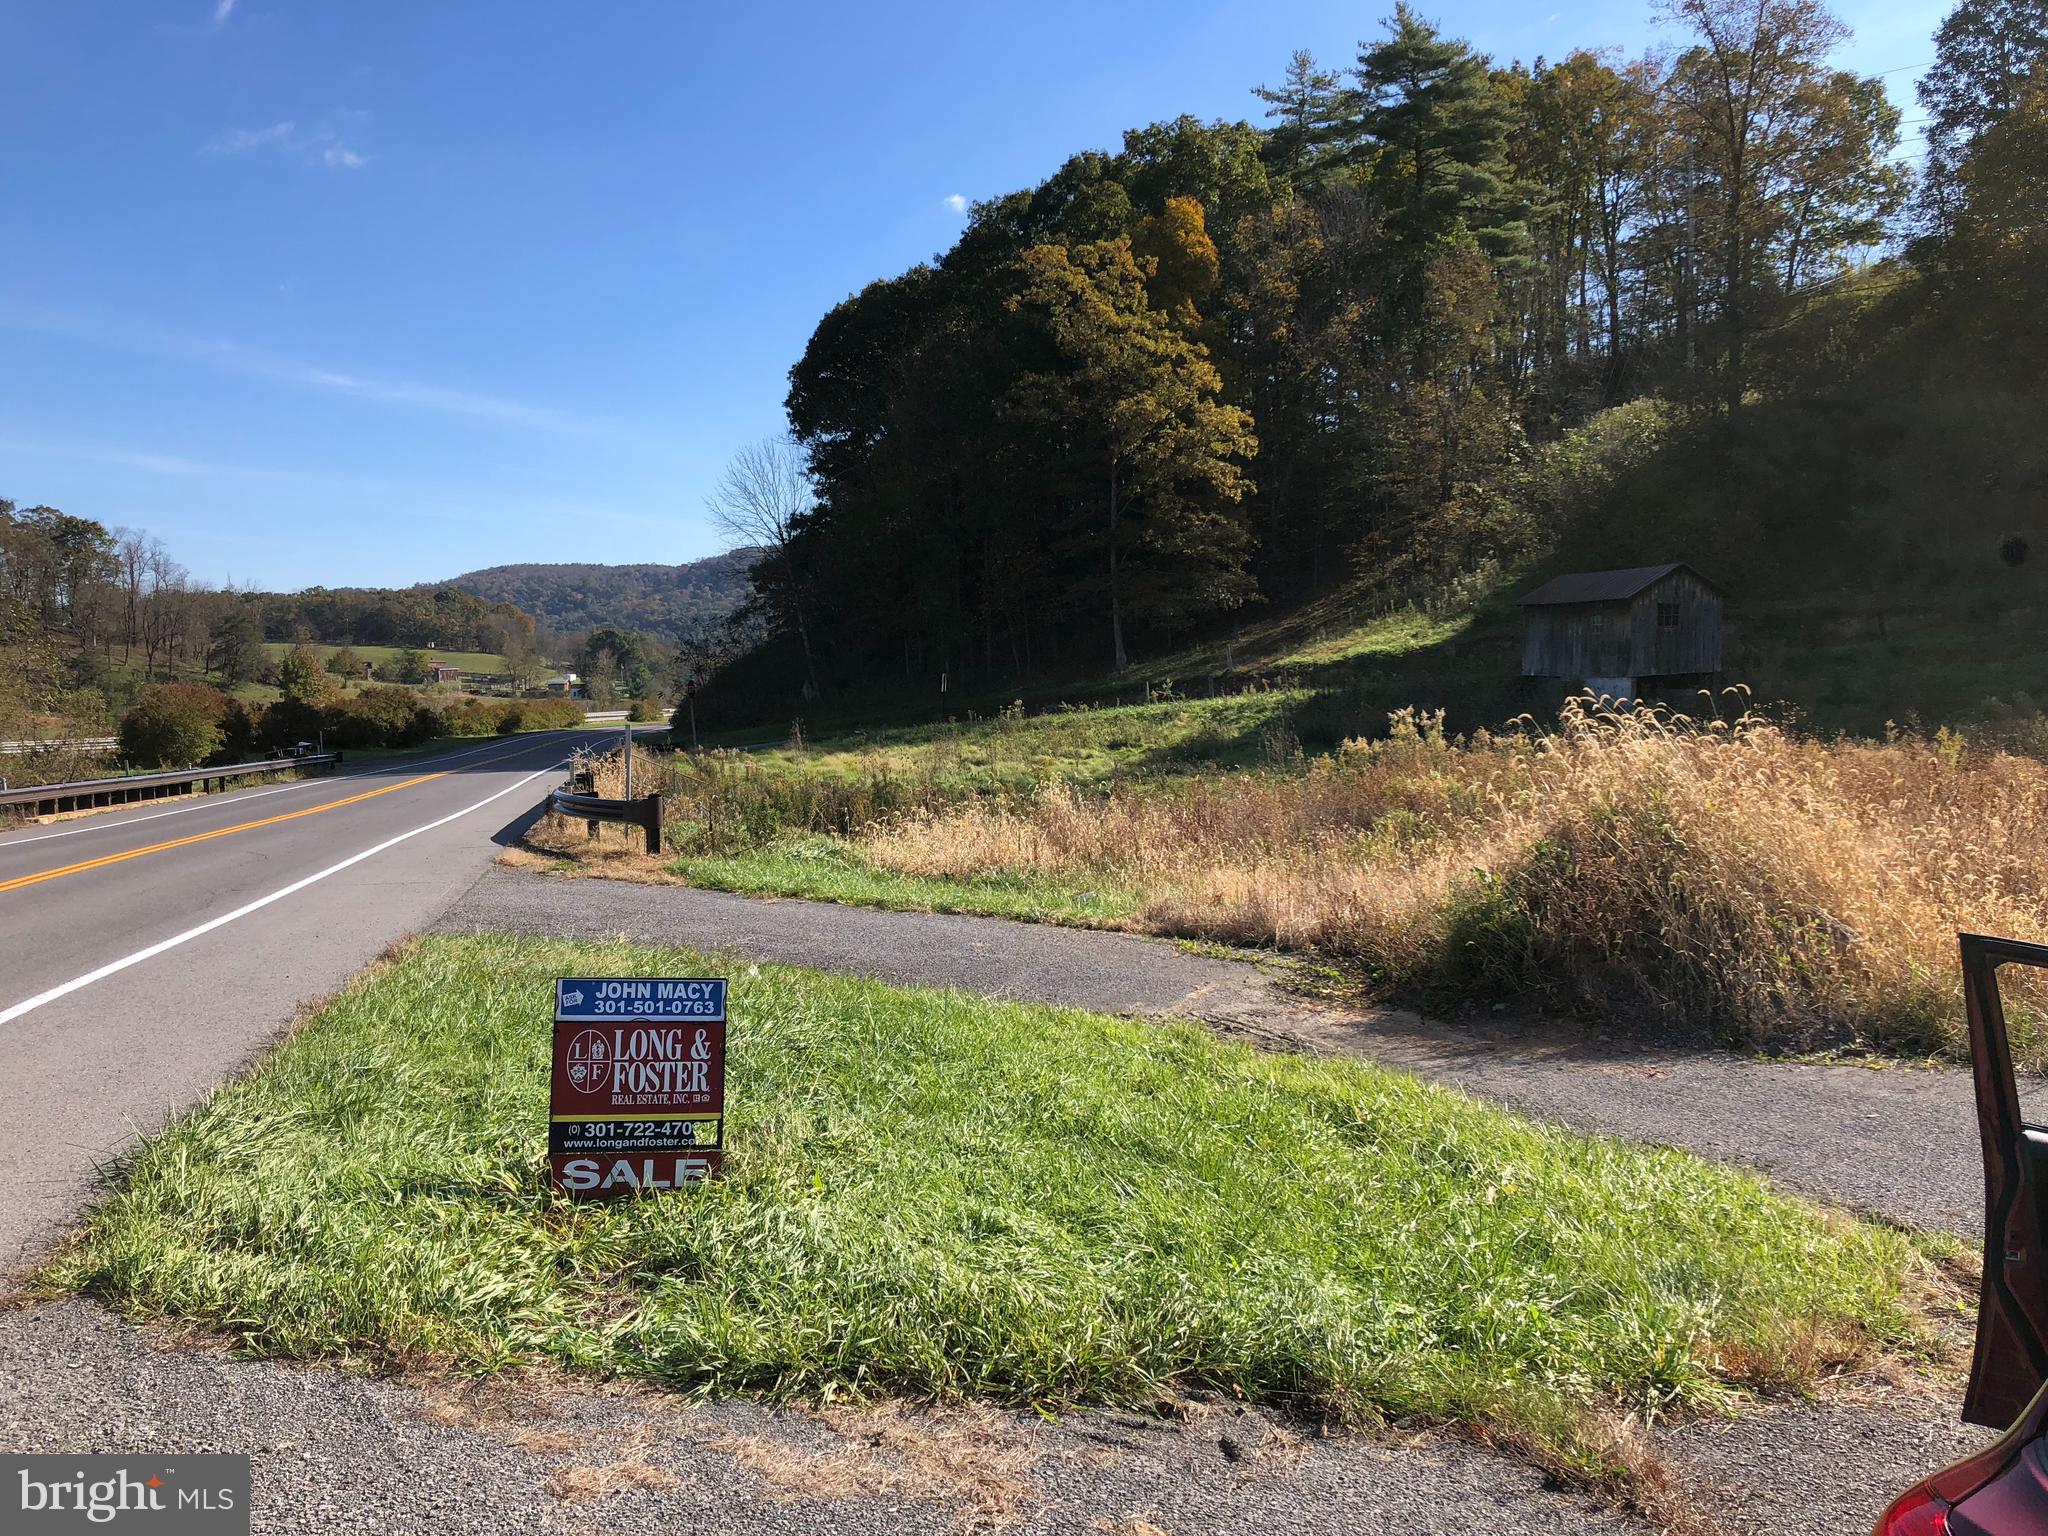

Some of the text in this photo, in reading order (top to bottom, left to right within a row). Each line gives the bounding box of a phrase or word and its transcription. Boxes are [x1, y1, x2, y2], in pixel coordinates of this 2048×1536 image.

[595, 982, 714, 999] JOHN MACY
[594, 1001, 715, 1014] 301-501-0763
[574, 1043, 587, 1059] L
[613, 1028, 712, 1060] LONG &
[591, 1064, 604, 1080] F
[611, 1061, 710, 1093] FOSTER
[611, 1094, 635, 1105] REAL
[636, 1093, 671, 1106] ESTATE,
[672, 1093, 690, 1105] INC.
[584, 1121, 700, 1137] 301-722-470
[564, 1137, 703, 1149] www.longandfoster.co
[562, 1159, 708, 1190] SALE
